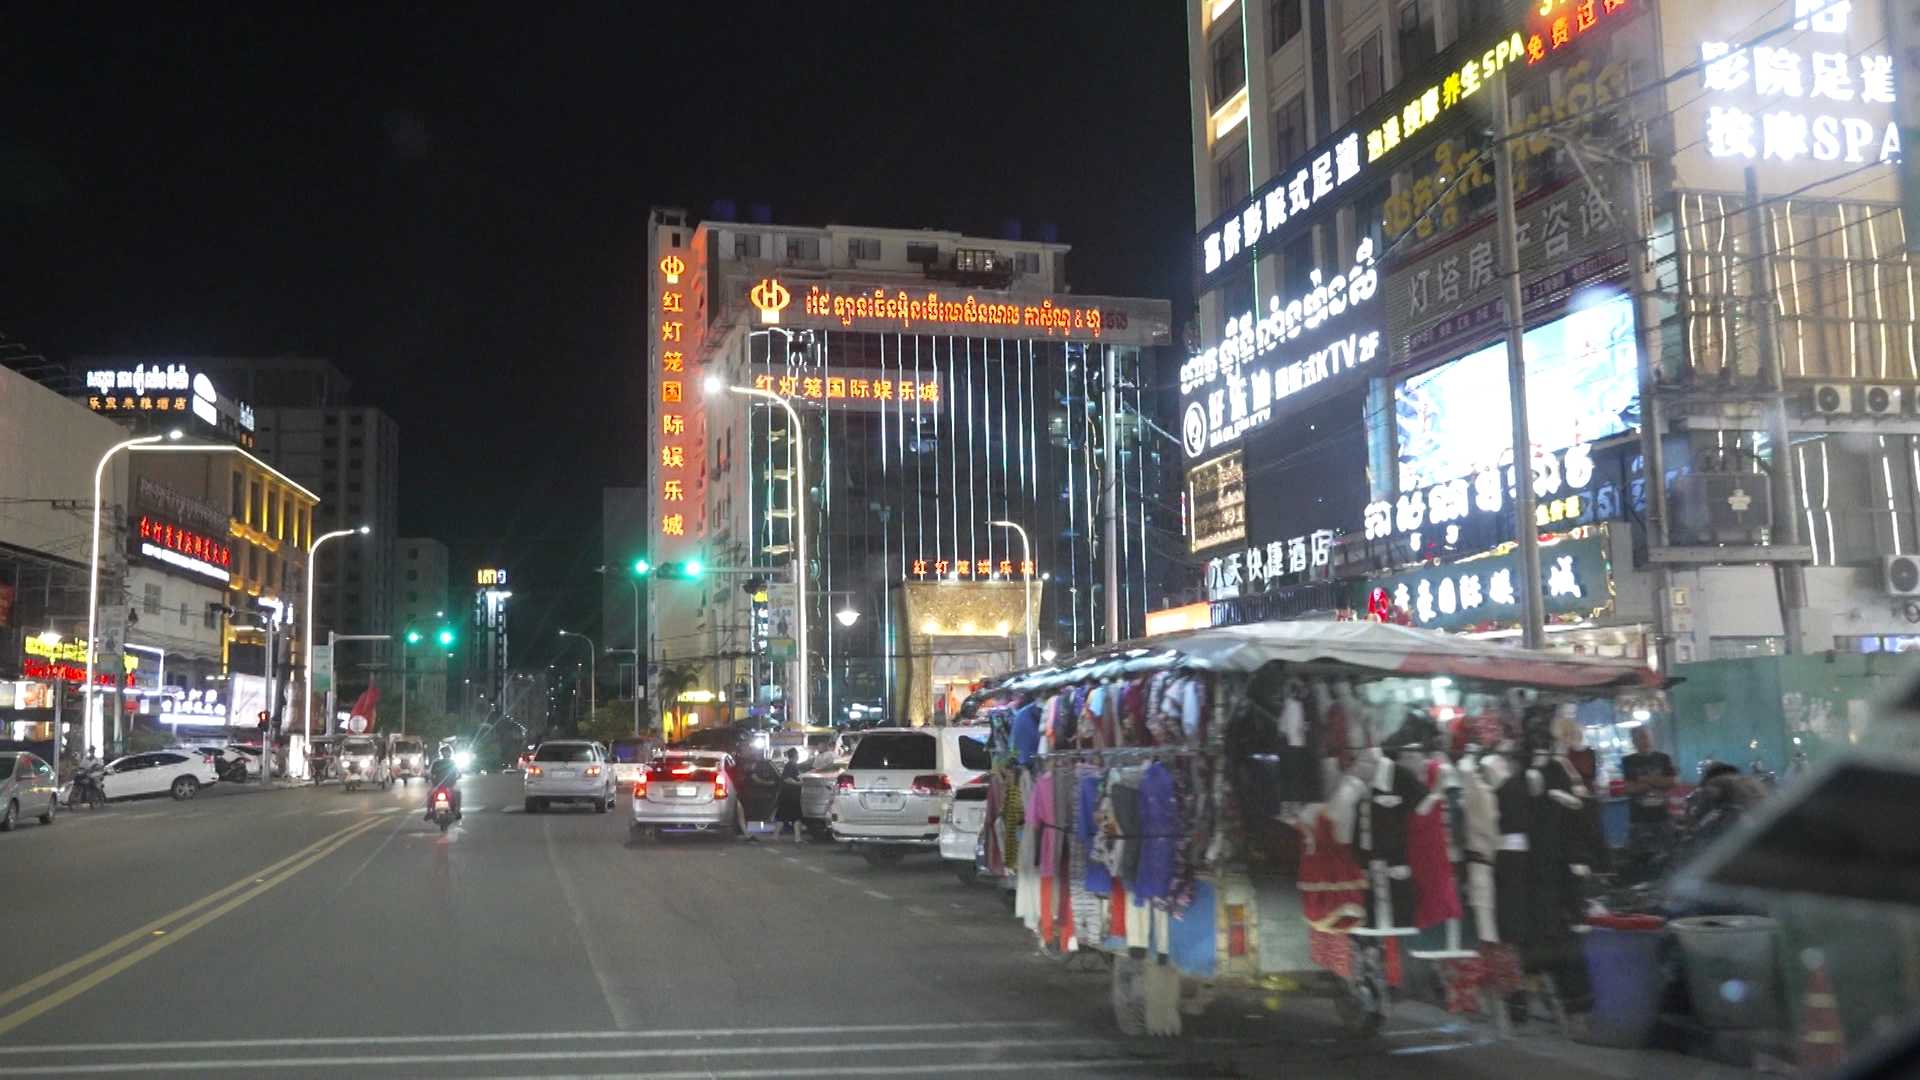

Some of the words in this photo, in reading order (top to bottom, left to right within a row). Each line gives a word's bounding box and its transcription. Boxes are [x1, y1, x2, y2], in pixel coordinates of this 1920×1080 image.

[1700, 41, 1897, 104] 影院足道
[1706, 106, 1903, 165] 按摩SPA
[661, 292, 685, 536] 红灯笼国际娱乐城
[754, 373, 940, 403] 红灯笼国际娱乐城
